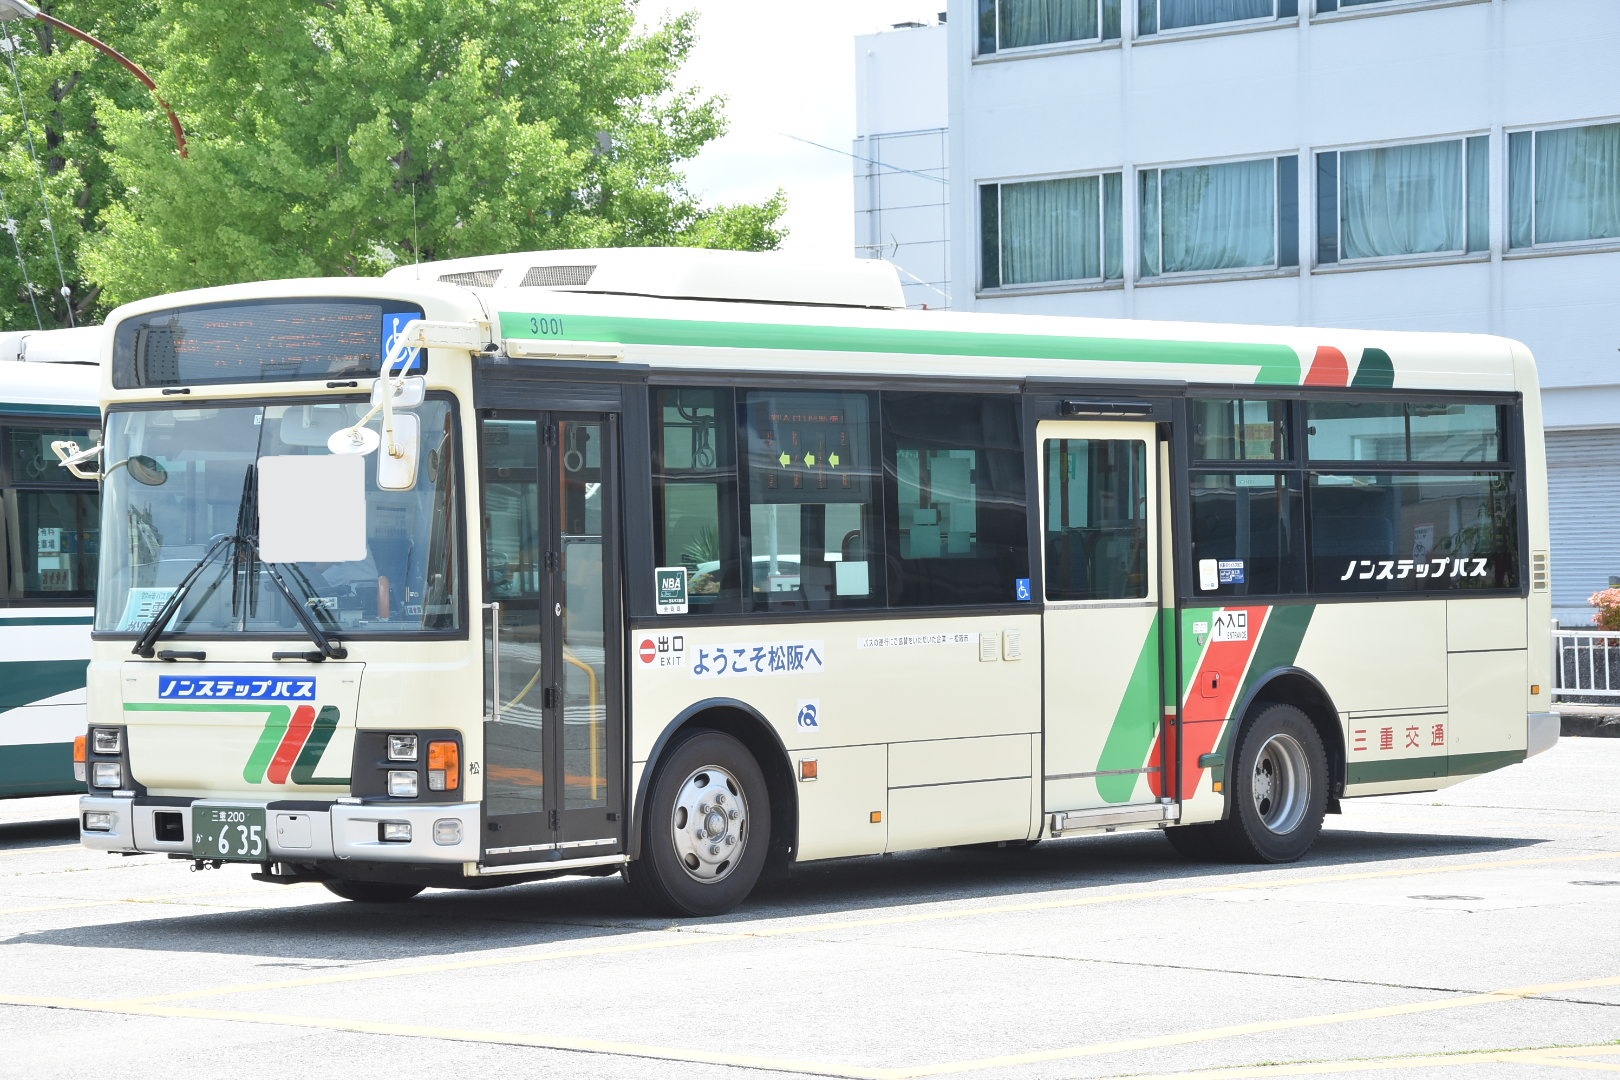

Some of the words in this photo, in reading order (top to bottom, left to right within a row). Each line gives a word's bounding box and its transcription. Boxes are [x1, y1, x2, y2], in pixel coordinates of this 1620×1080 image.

[530, 316, 564, 335] 3001
[1340, 556, 1488, 581] ノンステップバス
[662, 577, 681, 589] NBA
[1227, 613, 1246, 628] 入口
[658, 635, 684, 653] 出口
[660, 656, 682, 666] EXIT
[693, 644, 823, 675] ようこそ松阪へ
[161, 680, 314, 697] ノンステップバス
[1353, 723, 1445, 751] 三重交通
[469, 761, 480, 775] 松
